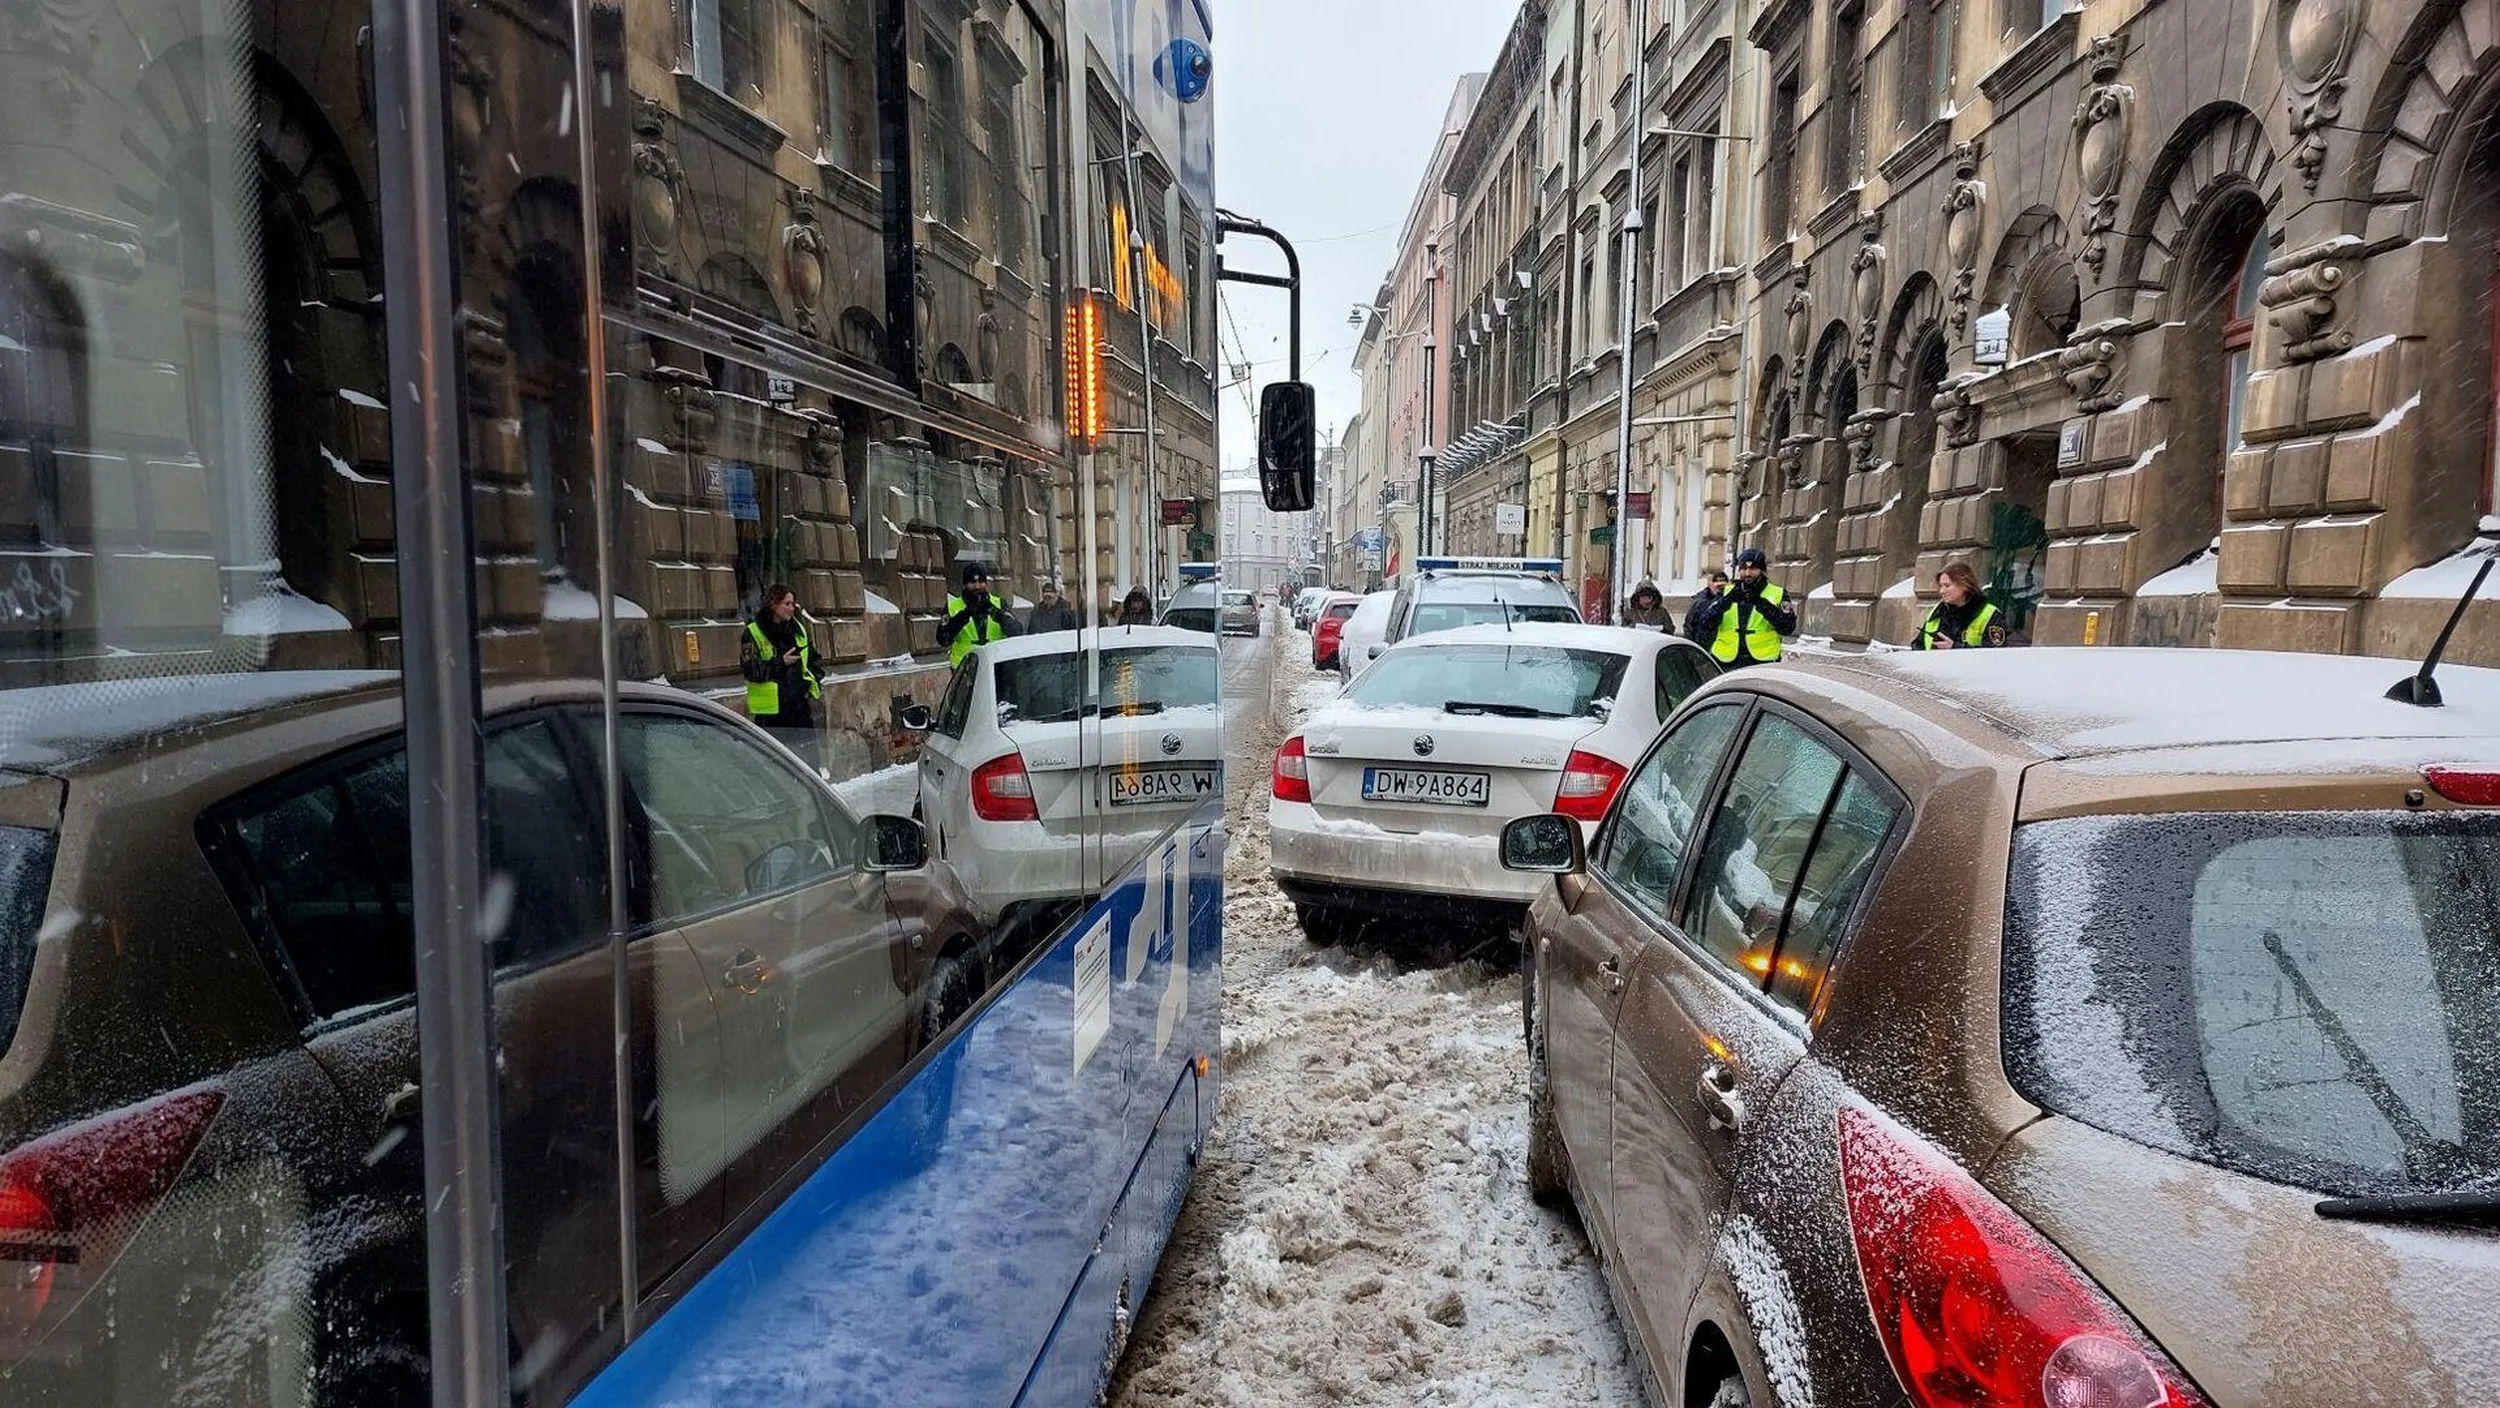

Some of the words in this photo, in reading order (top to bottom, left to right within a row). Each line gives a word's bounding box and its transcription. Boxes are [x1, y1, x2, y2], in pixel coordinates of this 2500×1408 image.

[1487, 561, 1522, 571] MIEJSKA
[1377, 772, 1408, 793] DW
[1416, 774, 1483, 798] 9A864
